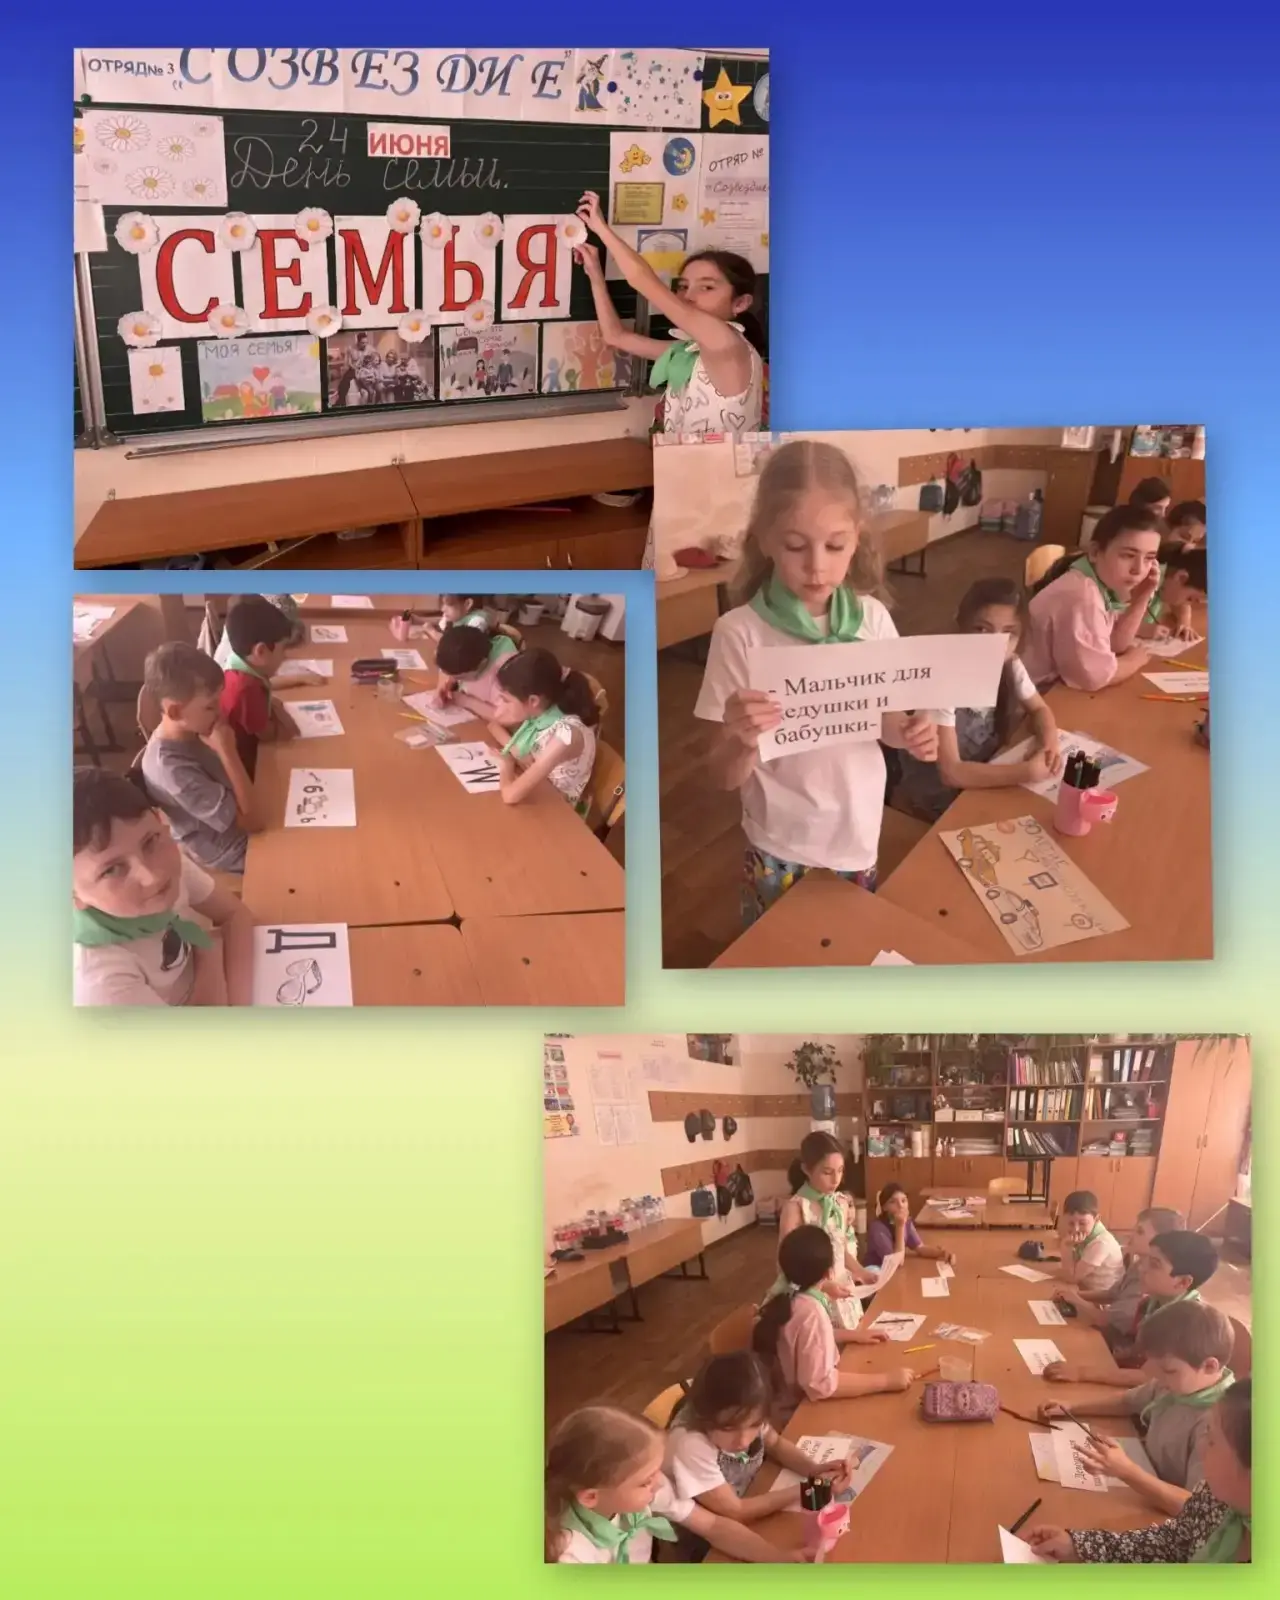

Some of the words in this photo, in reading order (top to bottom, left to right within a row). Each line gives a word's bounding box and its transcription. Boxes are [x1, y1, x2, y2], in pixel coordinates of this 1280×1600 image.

[167, 63, 175, 75] 3
[298, 118, 348, 155] 24
[369, 132, 449, 156] ИЮНЯ
[230, 136, 351, 189] День
[708, 152, 749, 172] ОТРЯД
[155, 226, 560, 324] СЕМЬЯ
[204, 342, 240, 359] МОЯ
[784, 669, 887, 697] Мальчик
[892, 666, 932, 683] для
[876, 695, 889, 708] и
